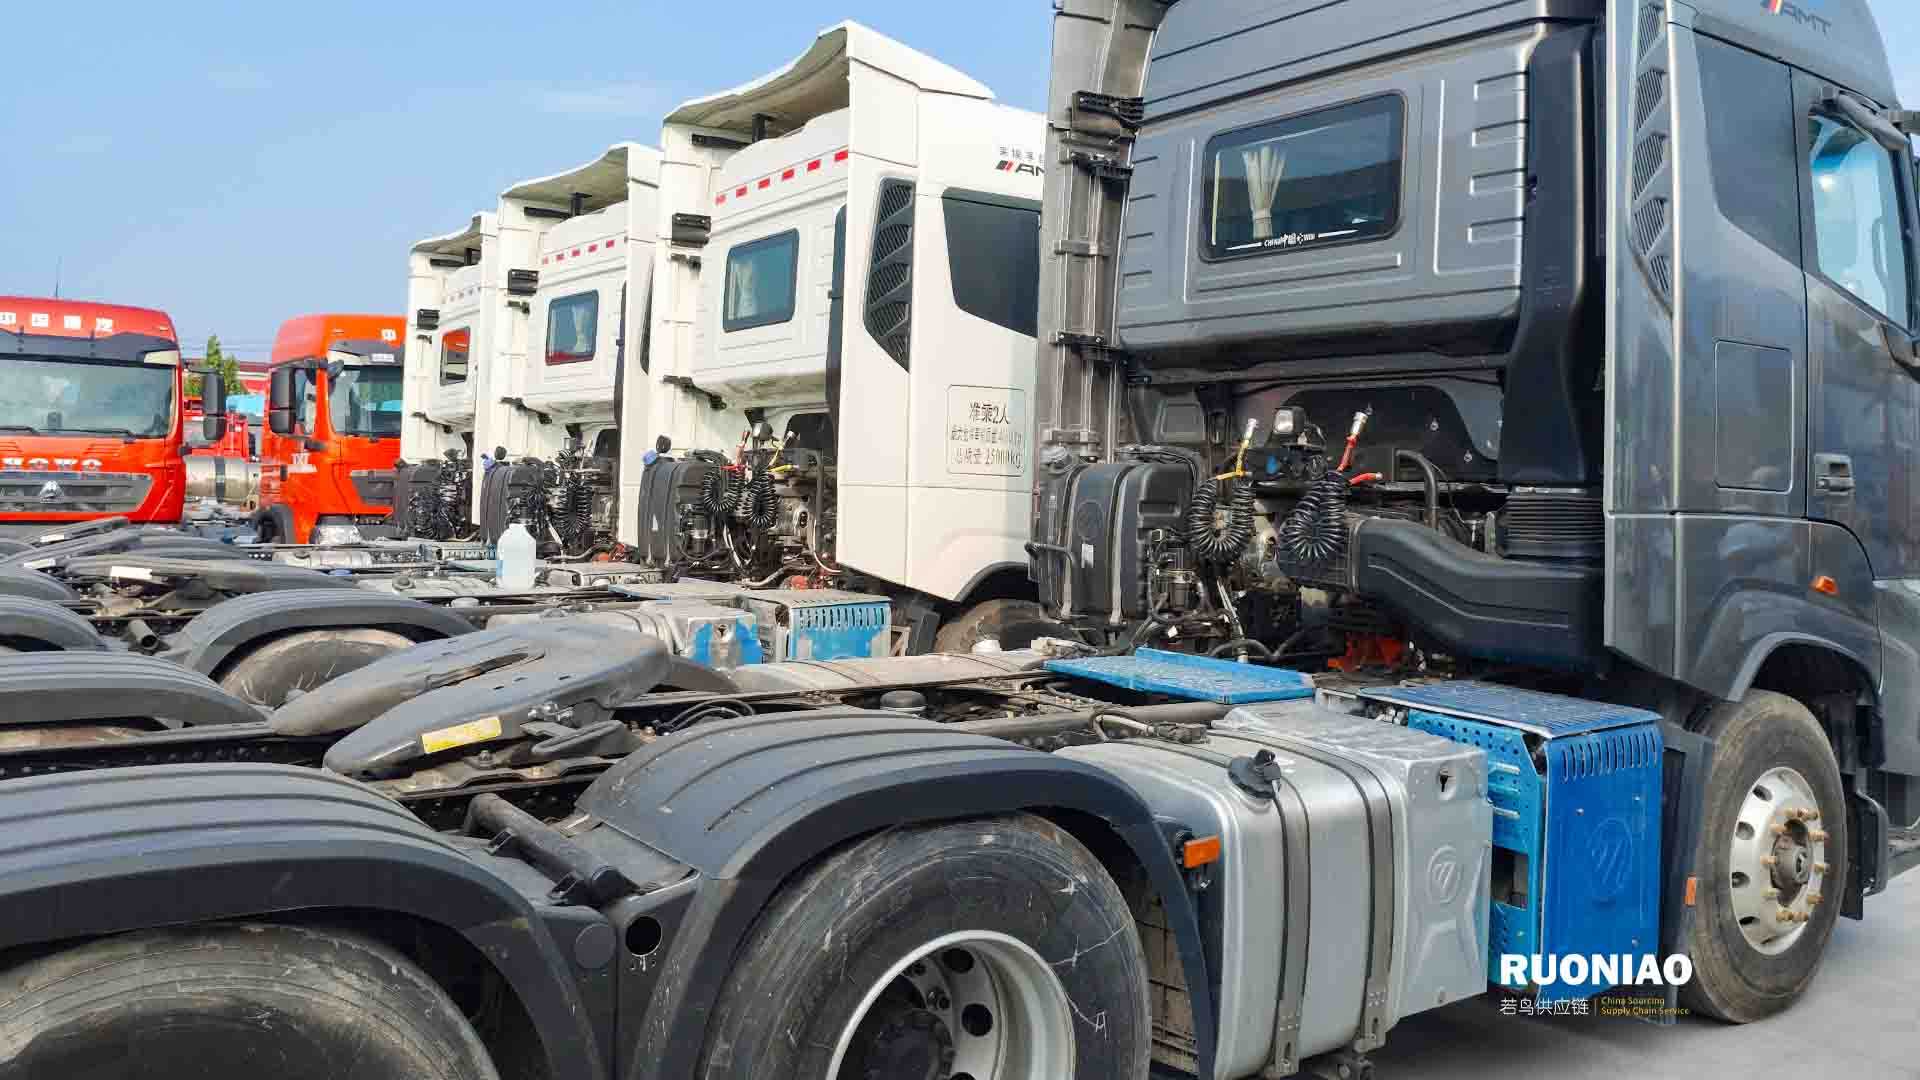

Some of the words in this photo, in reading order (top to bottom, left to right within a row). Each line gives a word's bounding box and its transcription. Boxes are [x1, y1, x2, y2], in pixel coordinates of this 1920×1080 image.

[1779, 1, 1832, 35] AMT
[969, 400, 1009, 424] 准乘2人
